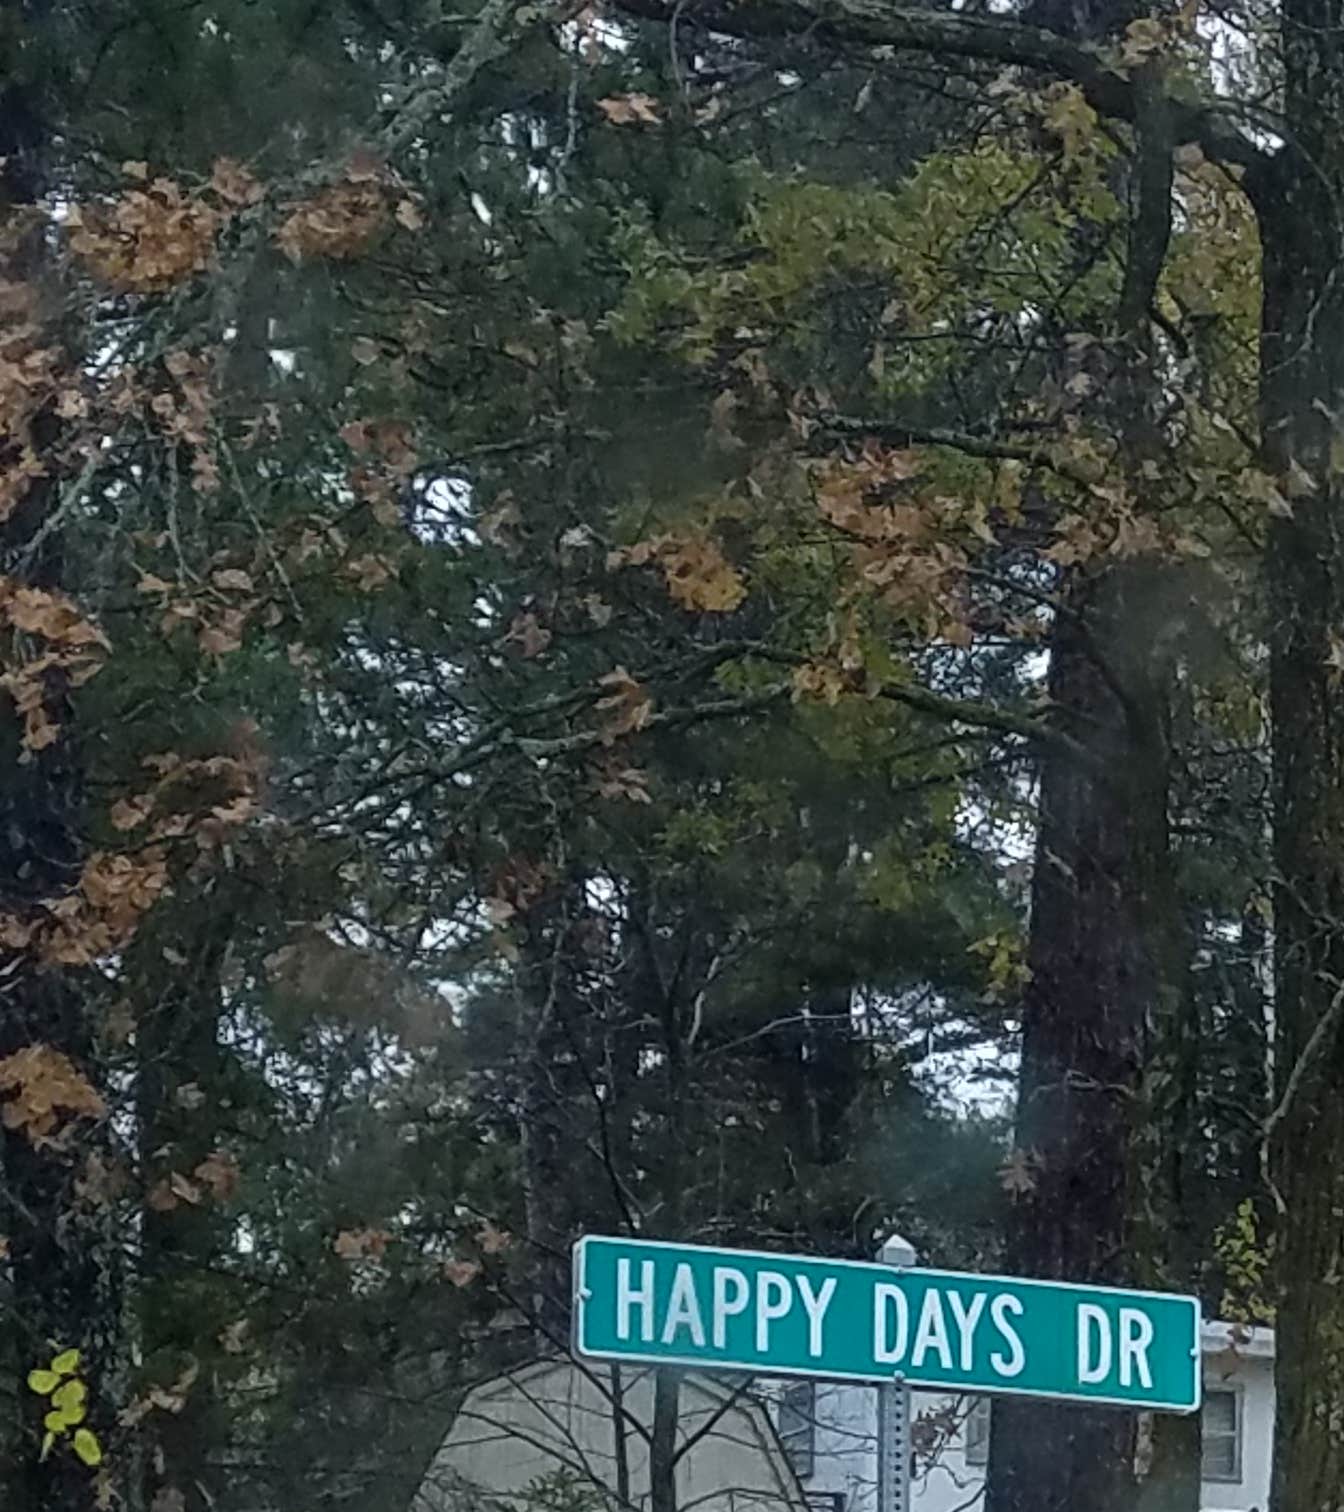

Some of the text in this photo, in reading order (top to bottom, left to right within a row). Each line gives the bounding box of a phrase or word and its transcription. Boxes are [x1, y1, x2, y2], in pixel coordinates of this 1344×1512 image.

[616, 1257, 1154, 1389] HAPPY DAYS DR
